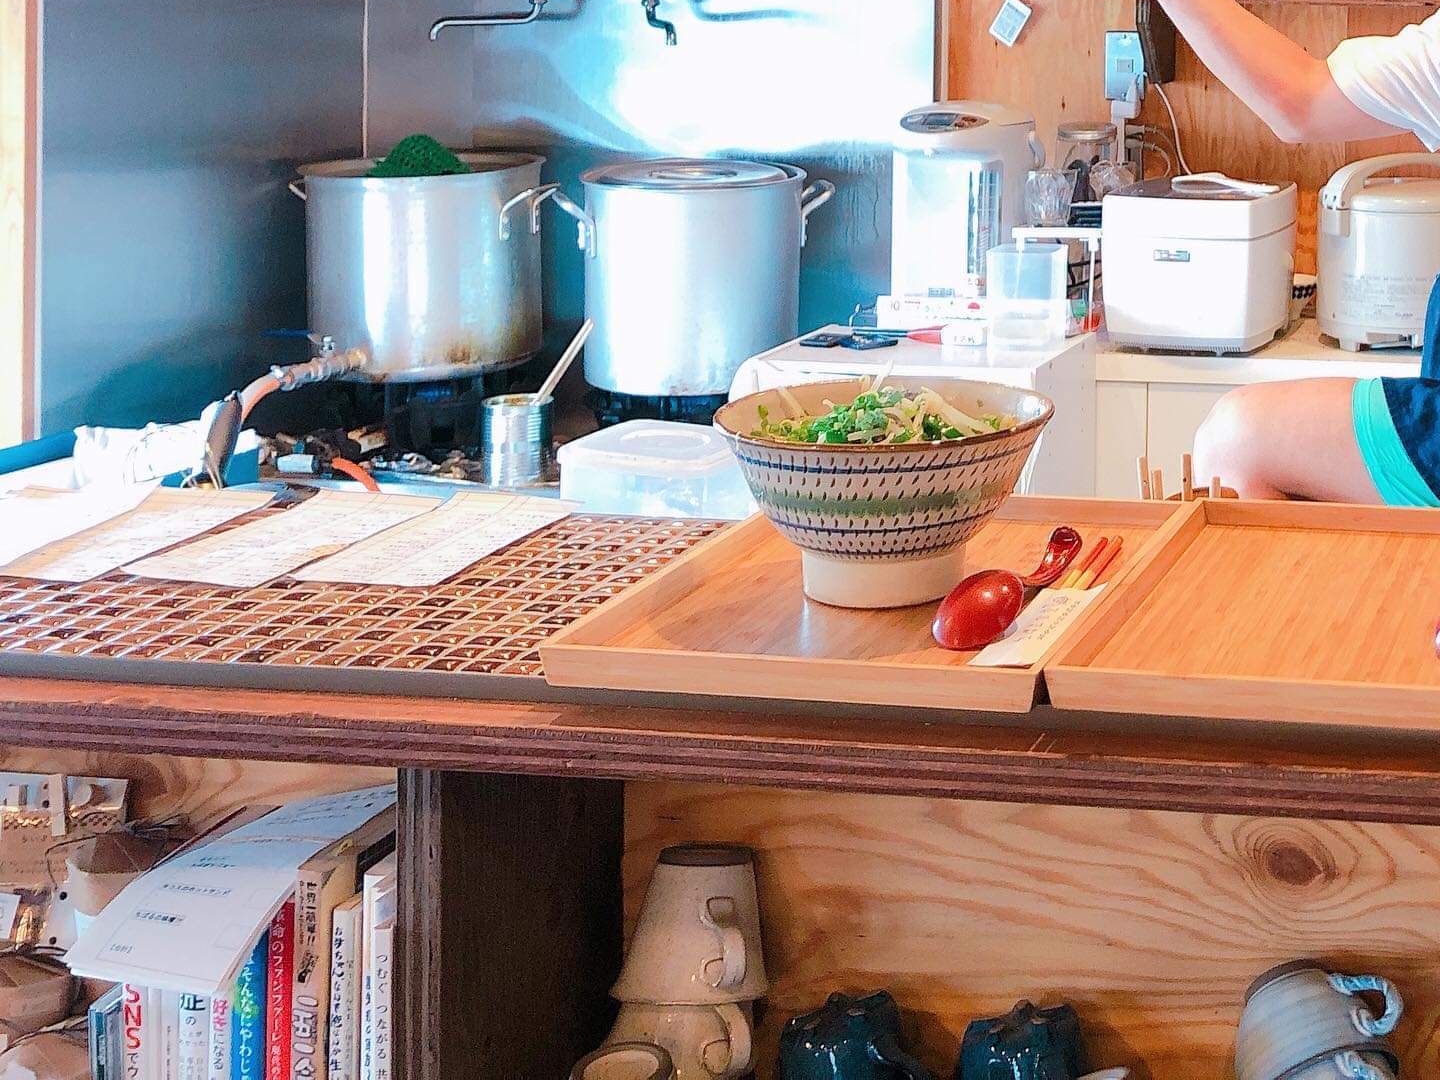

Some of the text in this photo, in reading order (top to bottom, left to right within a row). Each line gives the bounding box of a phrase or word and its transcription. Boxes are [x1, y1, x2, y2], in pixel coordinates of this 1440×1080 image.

[238, 955, 254, 1080] そんなにやわじ
